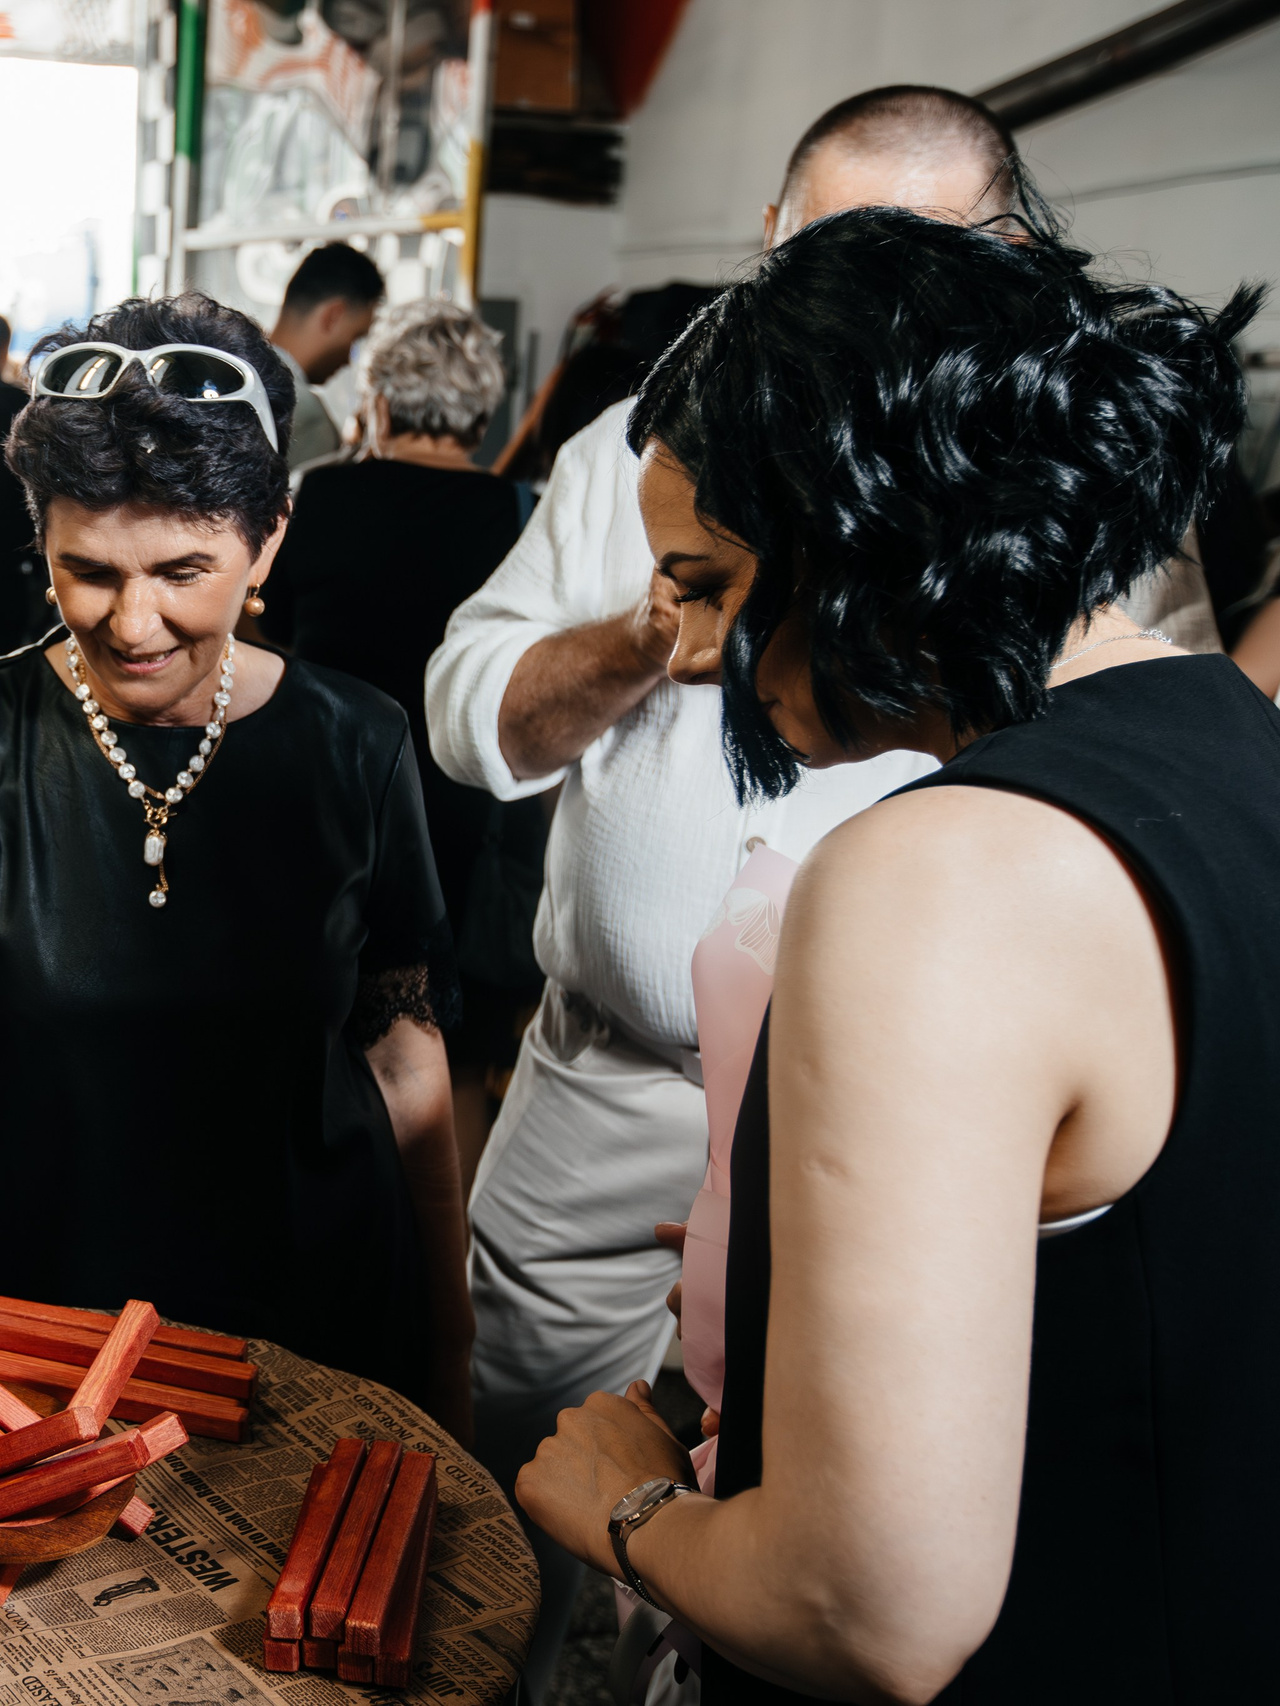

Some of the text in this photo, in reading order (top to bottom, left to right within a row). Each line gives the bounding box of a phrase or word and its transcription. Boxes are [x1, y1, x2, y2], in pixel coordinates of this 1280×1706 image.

[353, 1393, 414, 1439] INCREASED
[444, 1463, 490, 1494] RATED
[206, 1493, 234, 1517] into
[223, 1510, 257, 1538] look
[246, 1530, 265, 1545] to
[481, 1546, 519, 1573] GERMAN
[453, 1638, 498, 1670] ANGLAIS
